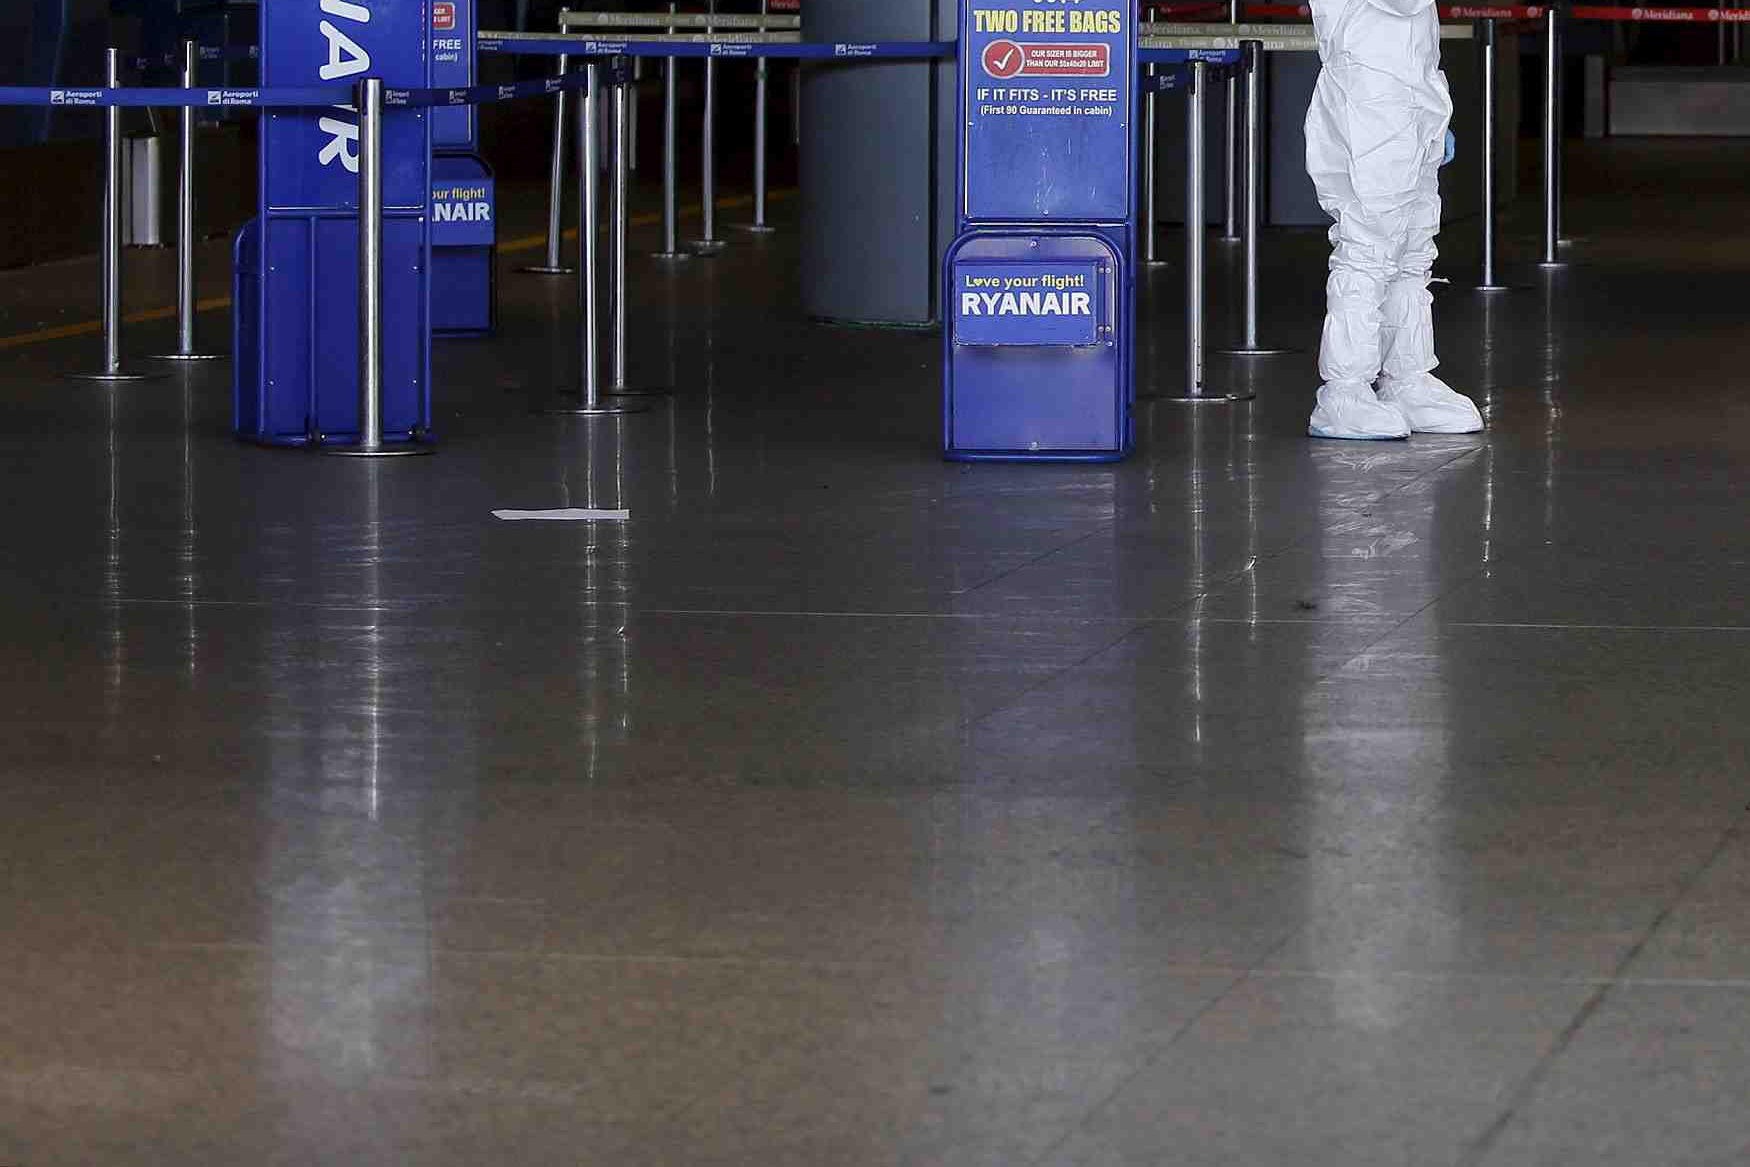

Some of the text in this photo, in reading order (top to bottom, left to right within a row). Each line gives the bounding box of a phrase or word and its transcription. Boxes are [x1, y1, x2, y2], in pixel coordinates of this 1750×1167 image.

[1463, 7, 1513, 18] Meridiana
[1642, 9, 1694, 21] Meridiana
[974, 9, 1121, 33] TWO FREE BAGS
[432, 39, 462, 50] FREE
[65, 90, 103, 99] Aeroporti
[222, 90, 260, 99] Aeroporti
[977, 88, 990, 101] IF
[993, 88, 1006, 101] IT
[1009, 88, 1040, 101] FITS
[1051, 88, 1078, 102] IT'S
[1080, 89, 1118, 102] FREE
[73, 97, 96, 105] Roma
[230, 97, 252, 105] Roma
[980, 104, 1113, 117] (First 90 Guaranteed in cabin)
[432, 202, 491, 222] NAIR
[965, 274, 1085, 291] Love your flight!
[961, 291, 1091, 315] RYANAIR
